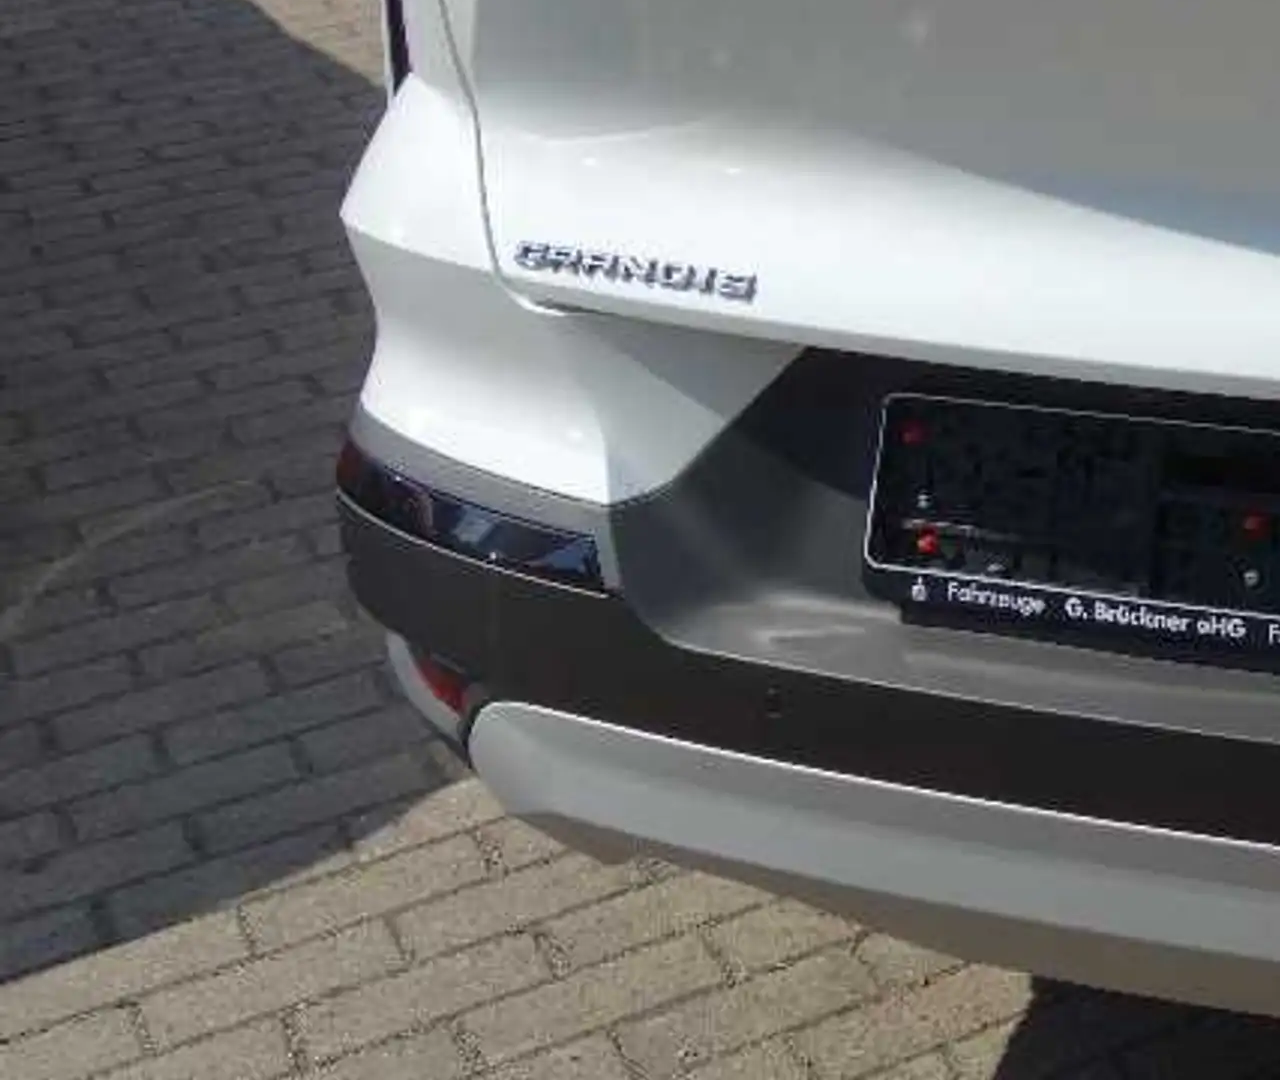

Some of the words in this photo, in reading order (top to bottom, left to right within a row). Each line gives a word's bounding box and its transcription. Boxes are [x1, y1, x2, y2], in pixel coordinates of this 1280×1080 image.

[514, 240, 758, 303] GRANDIS
[947, 582, 1046, 616] Fahrzeuge
[1064, 597, 1088, 620] G.
[1094, 602, 1188, 633] Brückner
[1196, 614, 1247, 638] oHG
